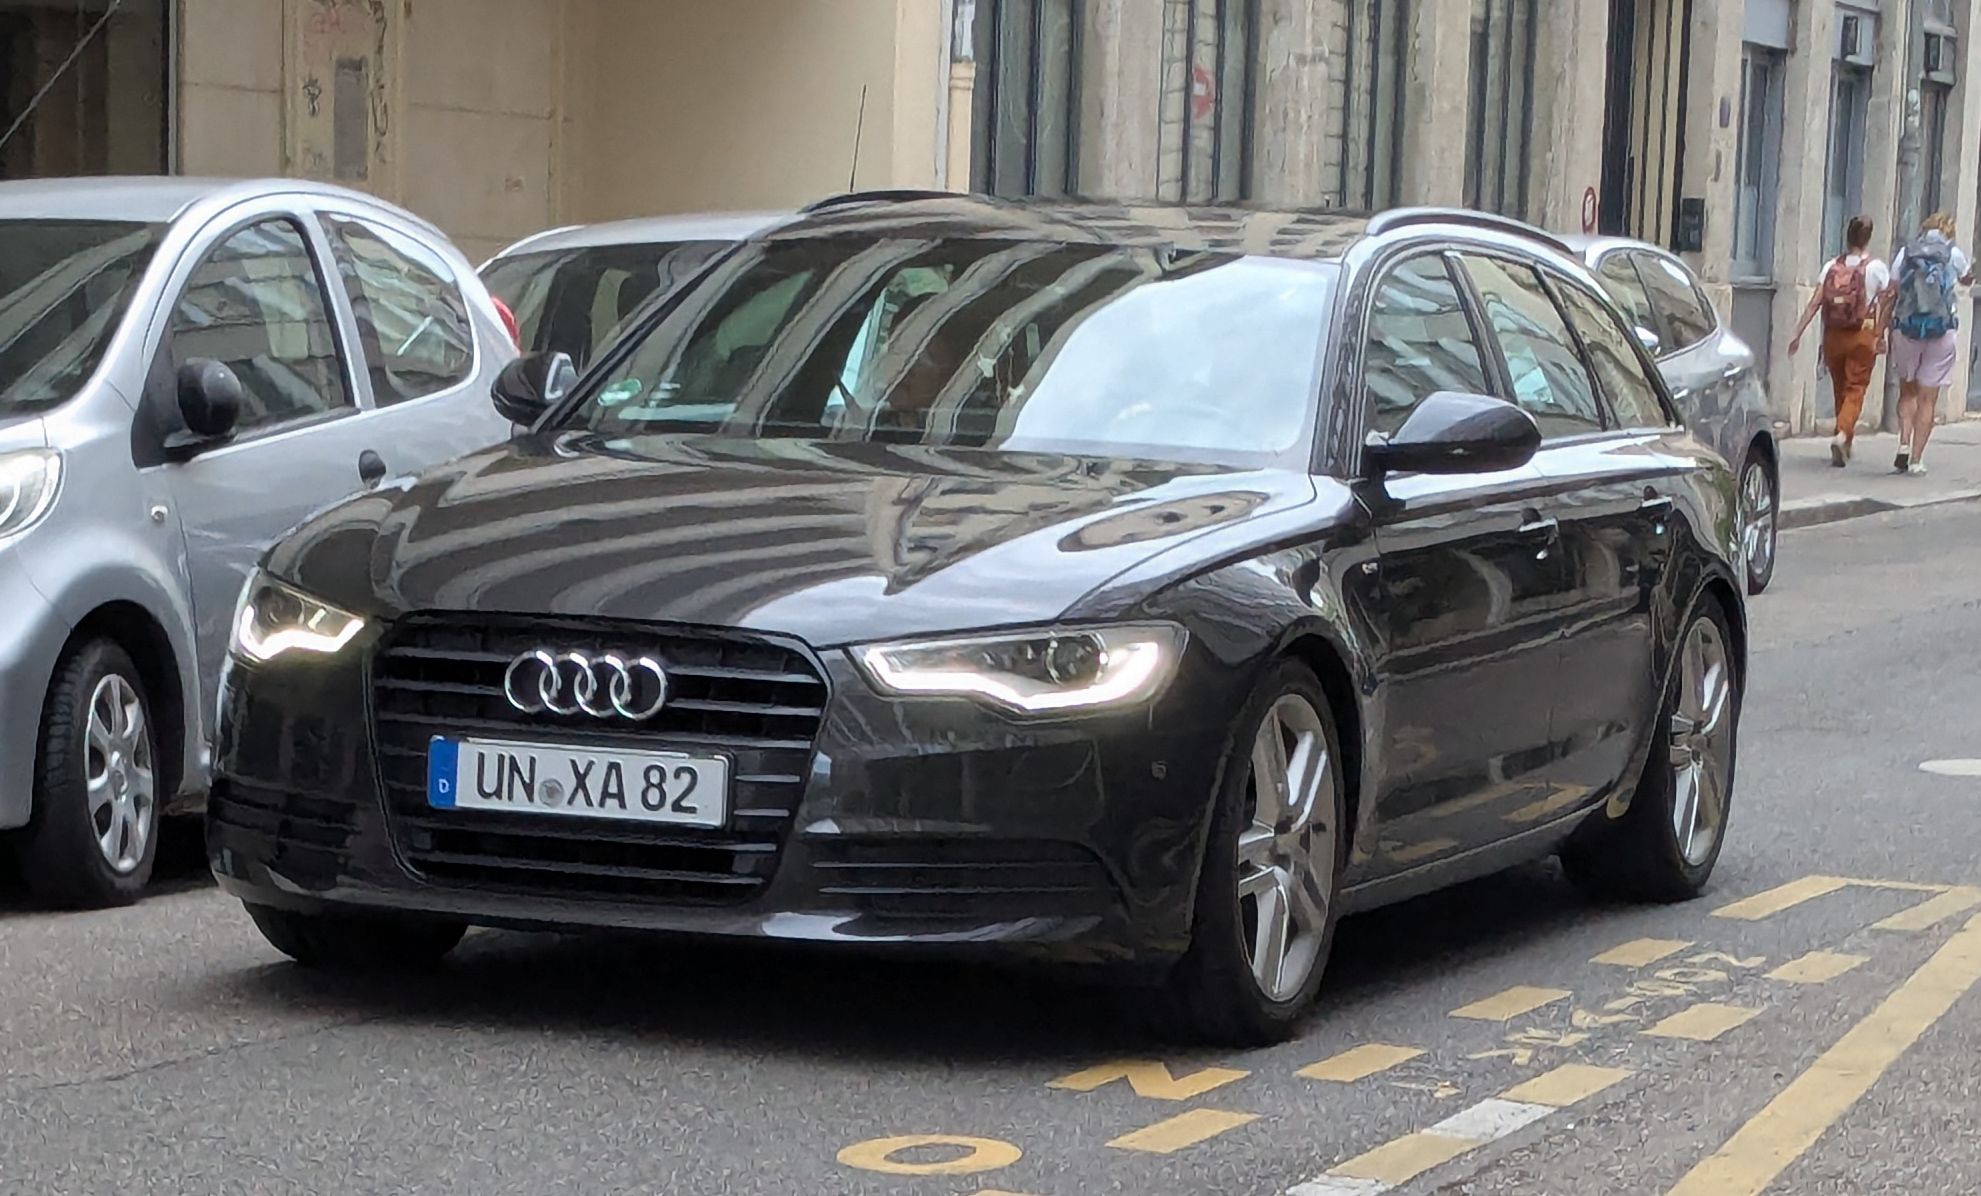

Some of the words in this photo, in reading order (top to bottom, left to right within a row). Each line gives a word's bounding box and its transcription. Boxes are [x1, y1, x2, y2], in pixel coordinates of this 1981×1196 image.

[439, 778, 450, 794] D
[477, 752, 536, 803] UN
[567, 758, 628, 810] XA
[641, 764, 698, 814] 82
